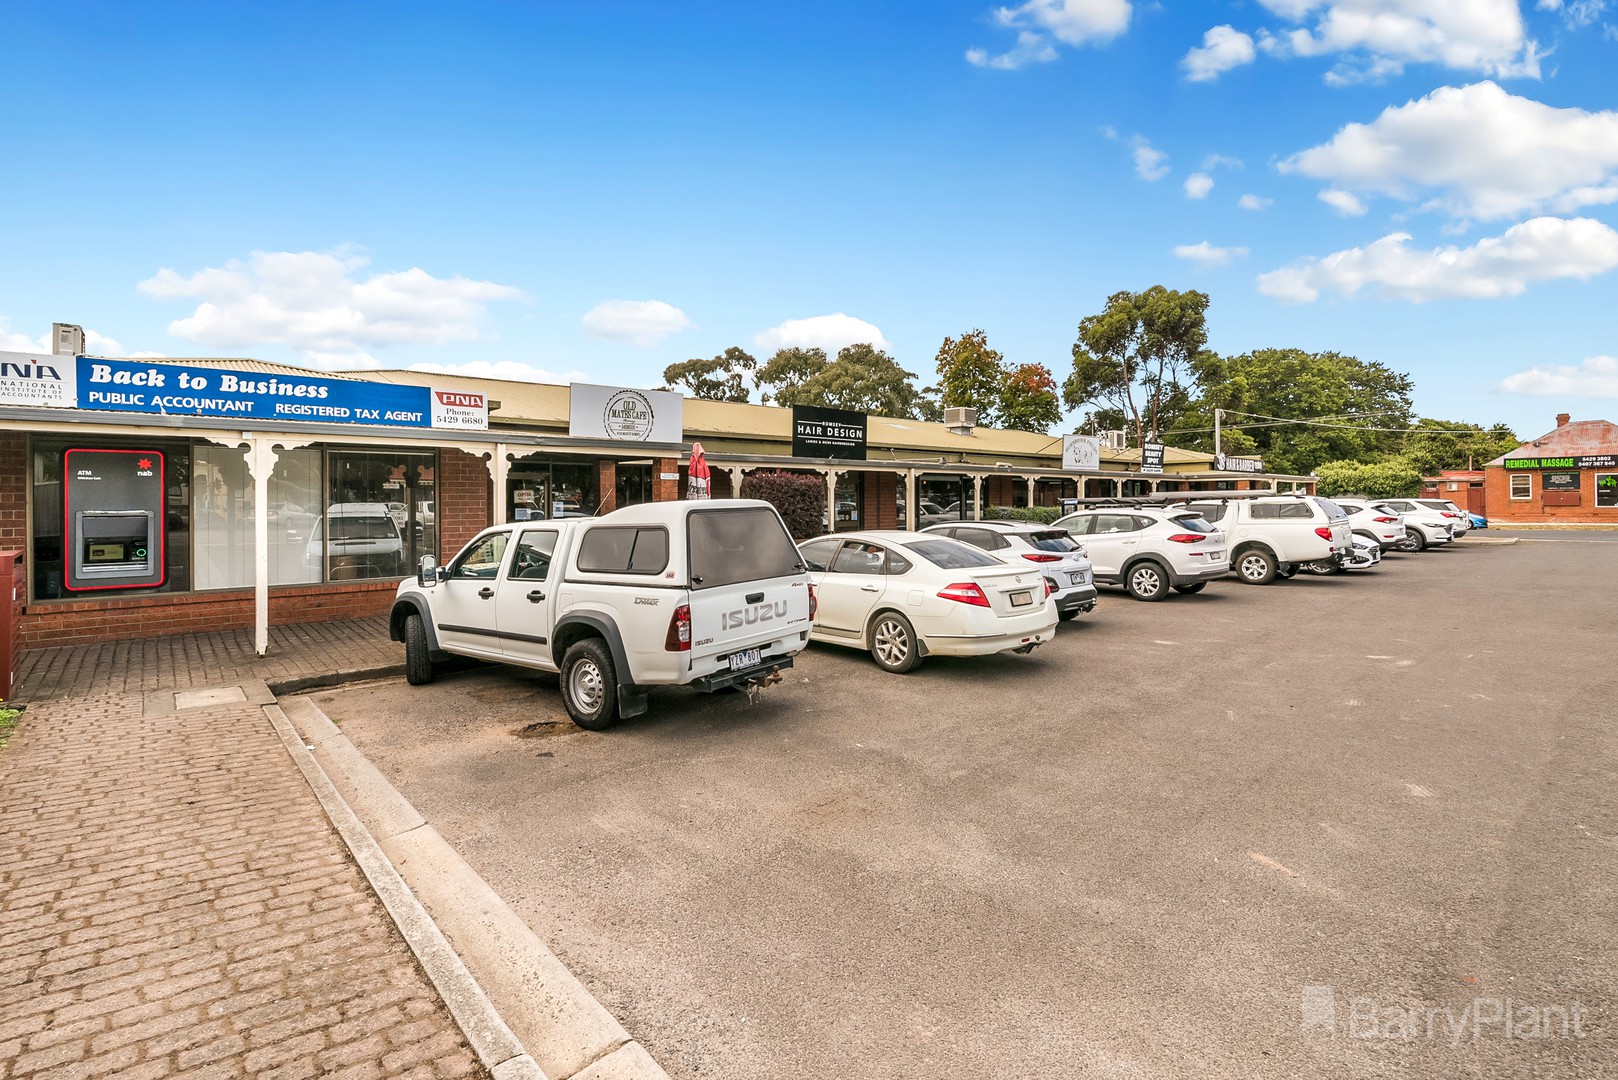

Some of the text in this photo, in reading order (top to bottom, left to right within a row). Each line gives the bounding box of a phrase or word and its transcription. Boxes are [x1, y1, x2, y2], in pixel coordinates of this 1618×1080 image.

[1, 380, 62, 390] NATIONAL
[89, 364, 328, 399] Back to Business
[1, 386, 47, 394] INSTITUTE
[1, 391, 62, 400] ACCOUNTANTS
[443, 394, 483, 407] PNA
[89, 391, 423, 422] PUBLIC ACCOUNTANT REGISTERED TAX AGENT
[623, 400, 637, 411] OLD
[446, 408, 474, 417] Phone:
[611, 409, 647, 420] MATES CAFE
[436, 415, 483, 425] 5429 6680
[797, 425, 863, 438] HAIR DESIGN
[1505, 458, 1574, 468] REMEDIAL MASSAGE
[721, 600, 788, 631] ISUZU
[695, 637, 714, 647] ISUZU
